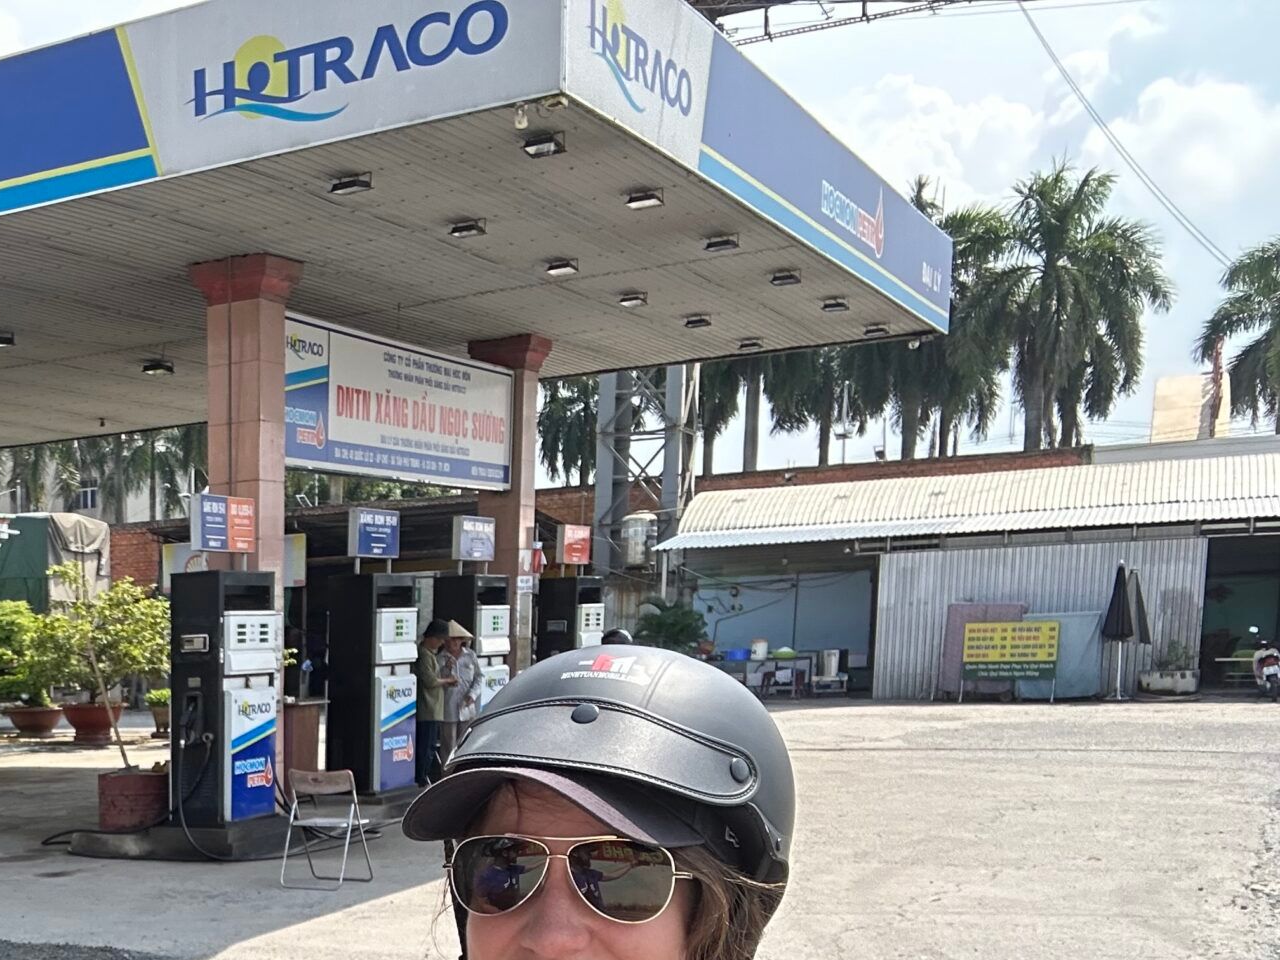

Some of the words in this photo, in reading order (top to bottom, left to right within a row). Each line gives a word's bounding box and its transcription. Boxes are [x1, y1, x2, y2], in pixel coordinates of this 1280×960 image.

[186, 0, 509, 117] HOTRACO
[336, 384, 371, 422] DNTN
[375, 390, 409, 429] XĂNG
[439, 405, 469, 445] NGỌC
